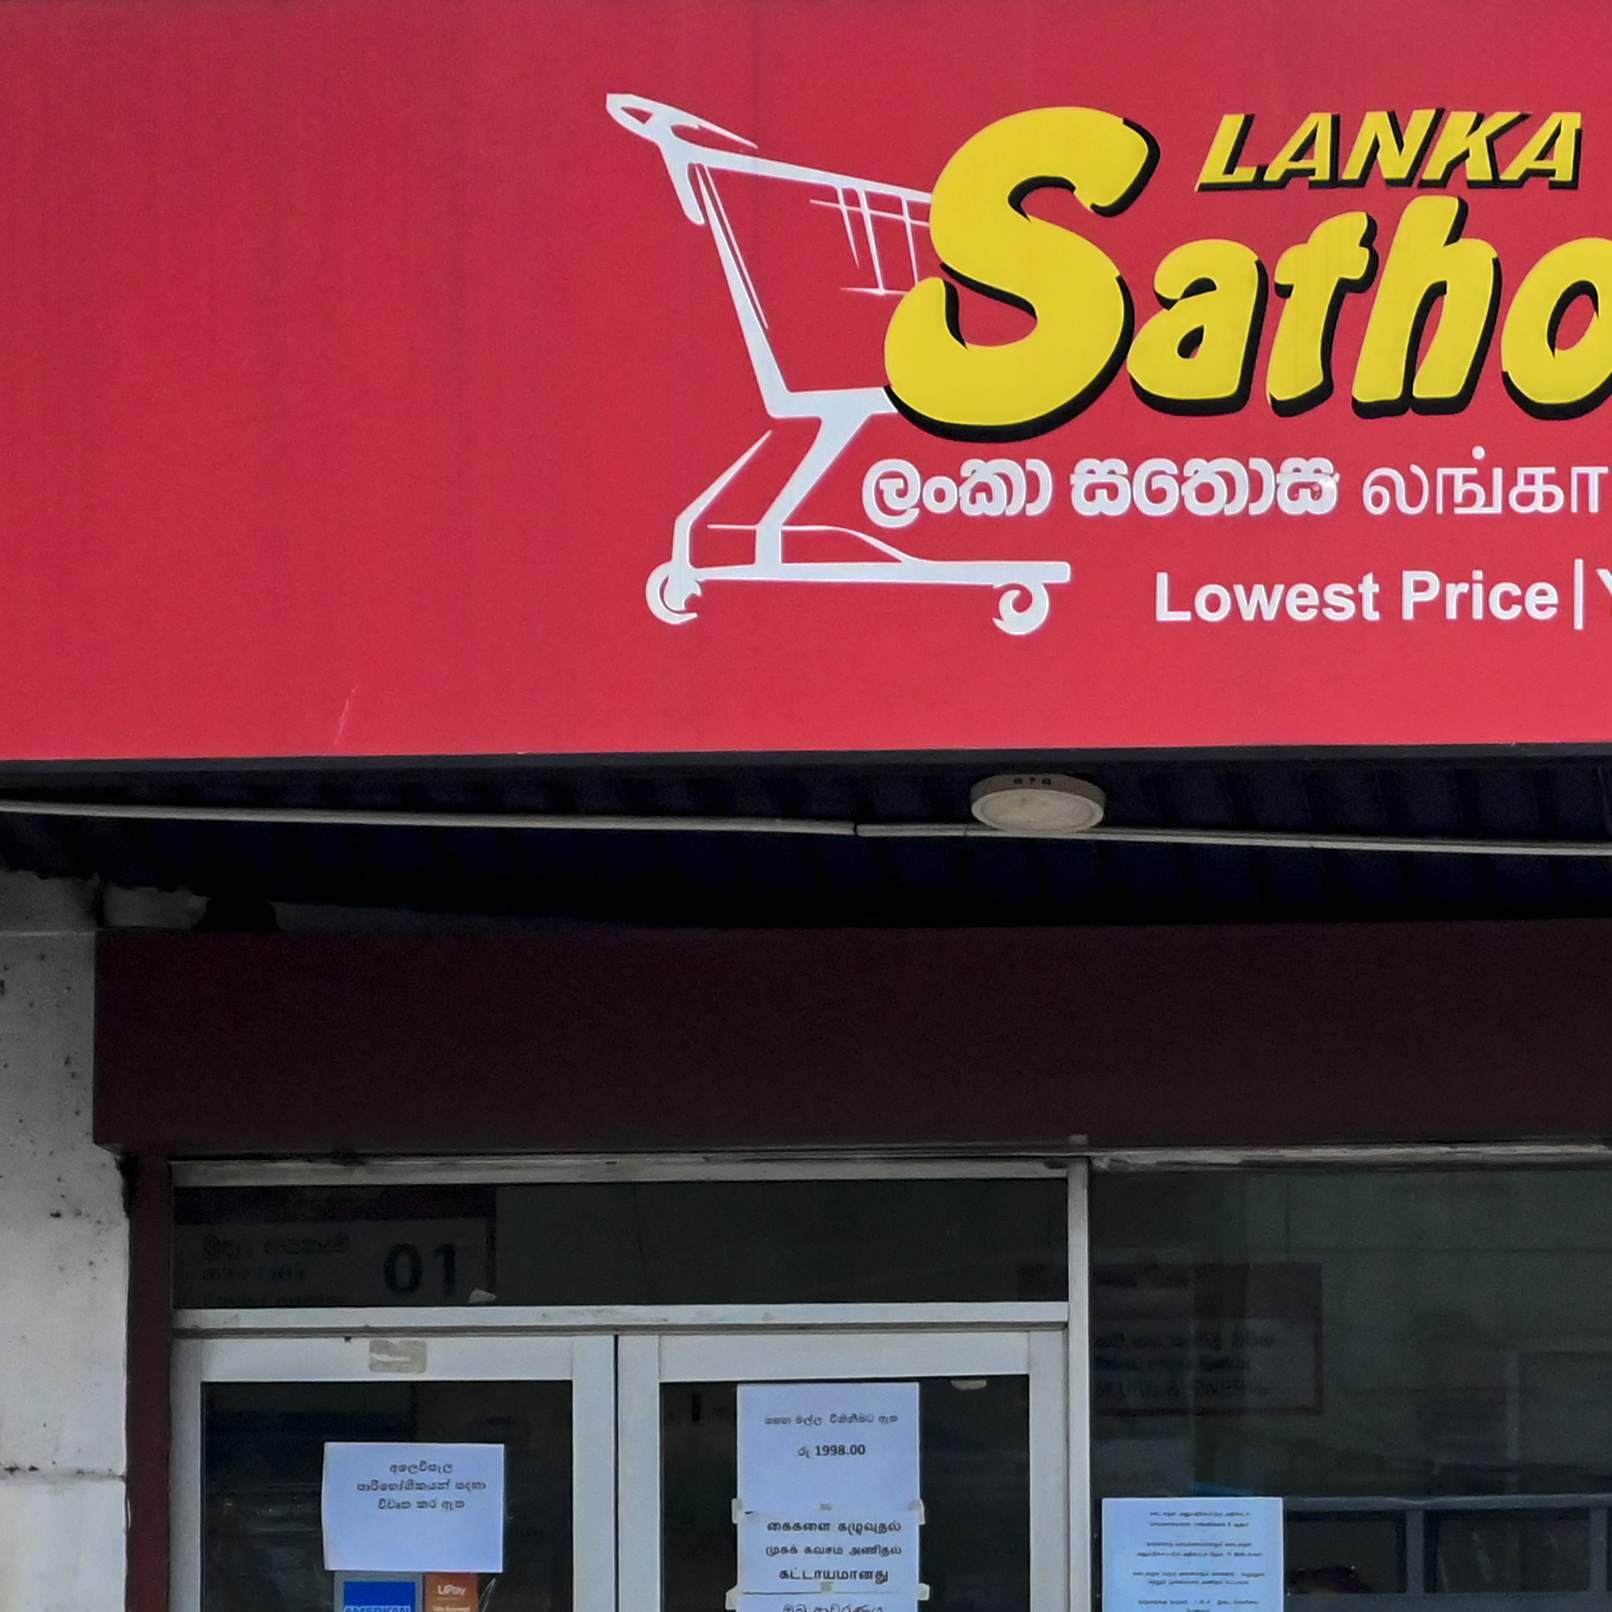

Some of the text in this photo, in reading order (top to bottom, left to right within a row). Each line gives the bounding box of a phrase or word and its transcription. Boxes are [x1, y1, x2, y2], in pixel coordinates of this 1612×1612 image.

[1194, 109, 1585, 190] LANKA
[861, 456, 1342, 530] ලංකා සතොස
[1363, 446, 1610, 517] லங்கா
[1156, 572, 1382, 623] Lowest
[1402, 570, 1560, 622] Price
[814, 1444, 866, 1456] 1998.00
